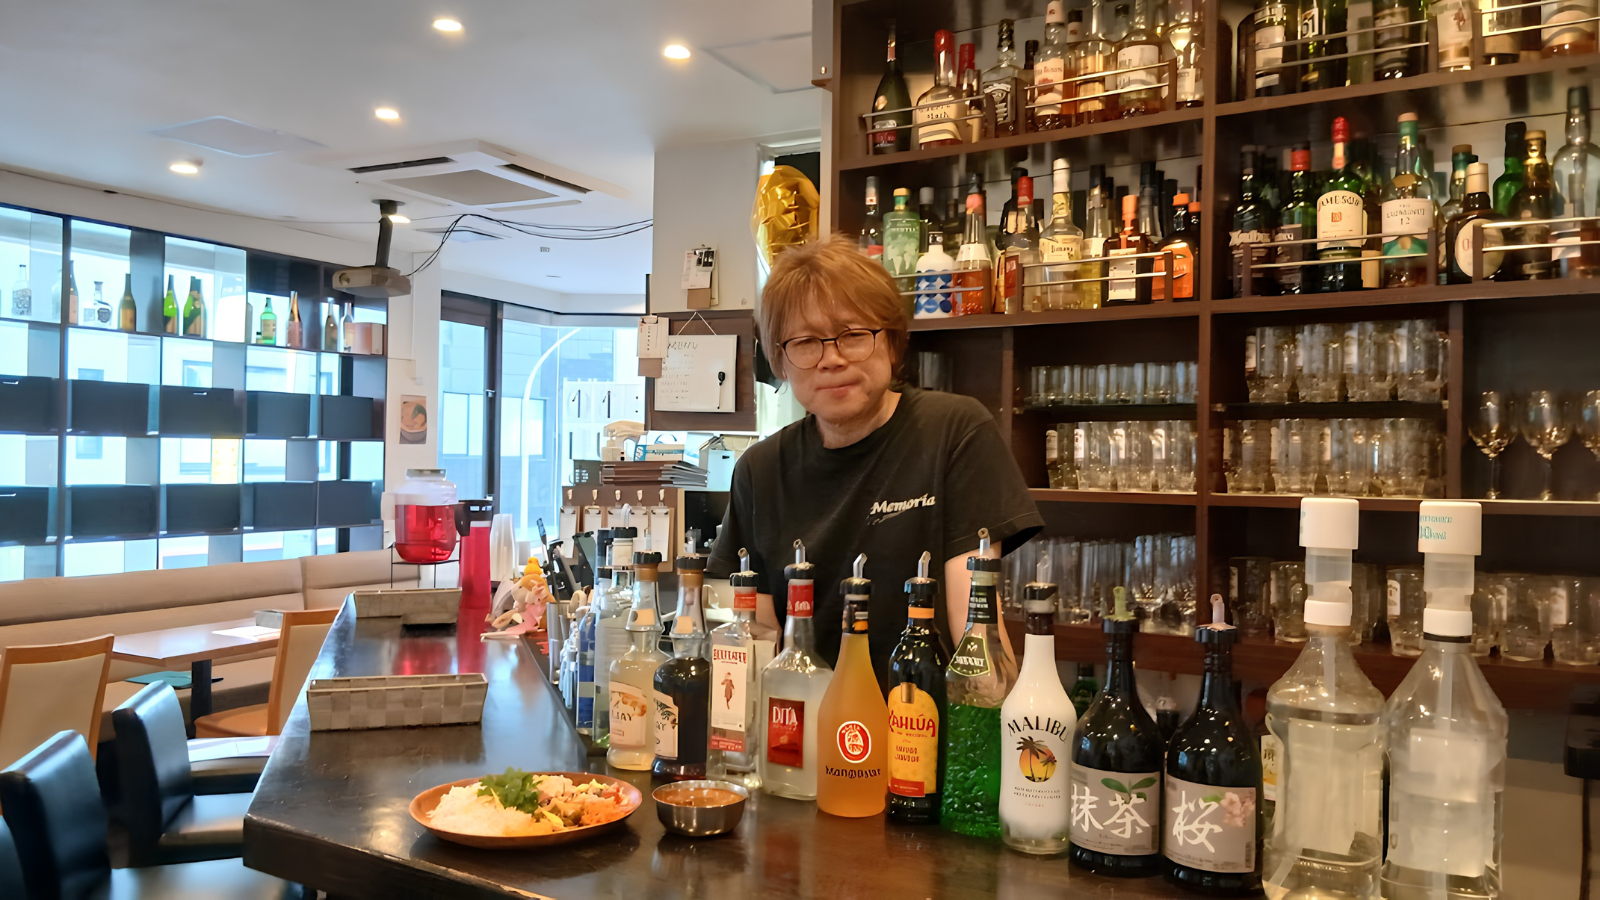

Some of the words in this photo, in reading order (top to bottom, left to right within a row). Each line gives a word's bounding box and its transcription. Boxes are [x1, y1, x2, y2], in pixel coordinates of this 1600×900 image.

[869, 492, 936, 515] Memoria
[772, 705, 798, 727] DITA
[1007, 715, 1070, 744] MALIBU
[1070, 783, 1150, 839] 抹茶
[1171, 790, 1224, 854] 桜
